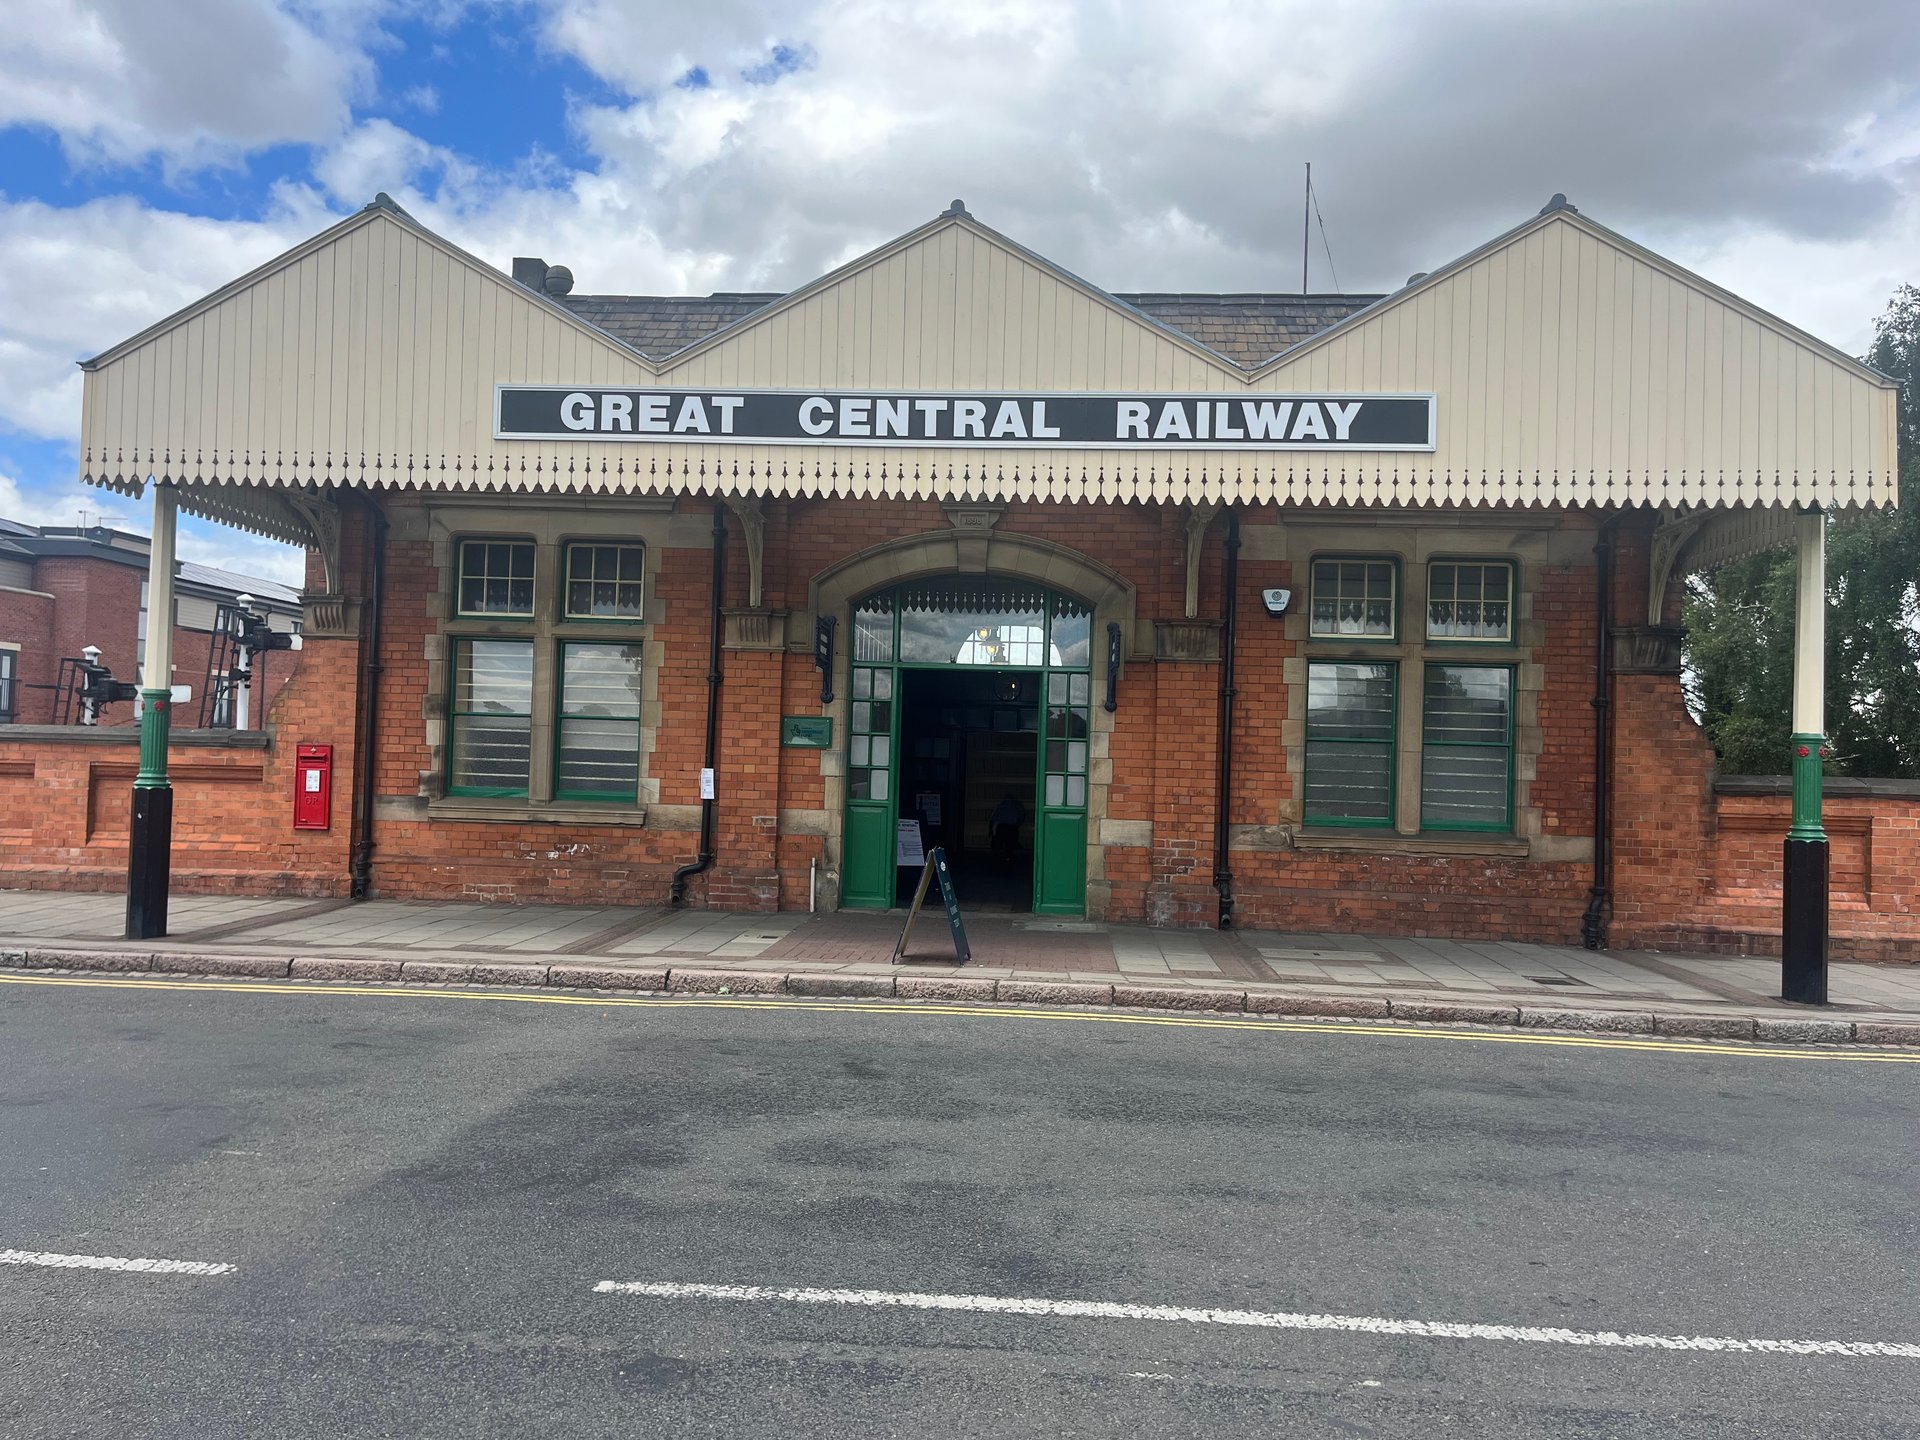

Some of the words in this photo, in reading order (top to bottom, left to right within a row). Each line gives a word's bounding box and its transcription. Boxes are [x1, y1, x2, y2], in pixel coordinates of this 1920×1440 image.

[560, 392, 745, 434] GREAT
[798, 397, 1061, 438] CENTRAL
[1116, 401, 1364, 440] RAILWAY
